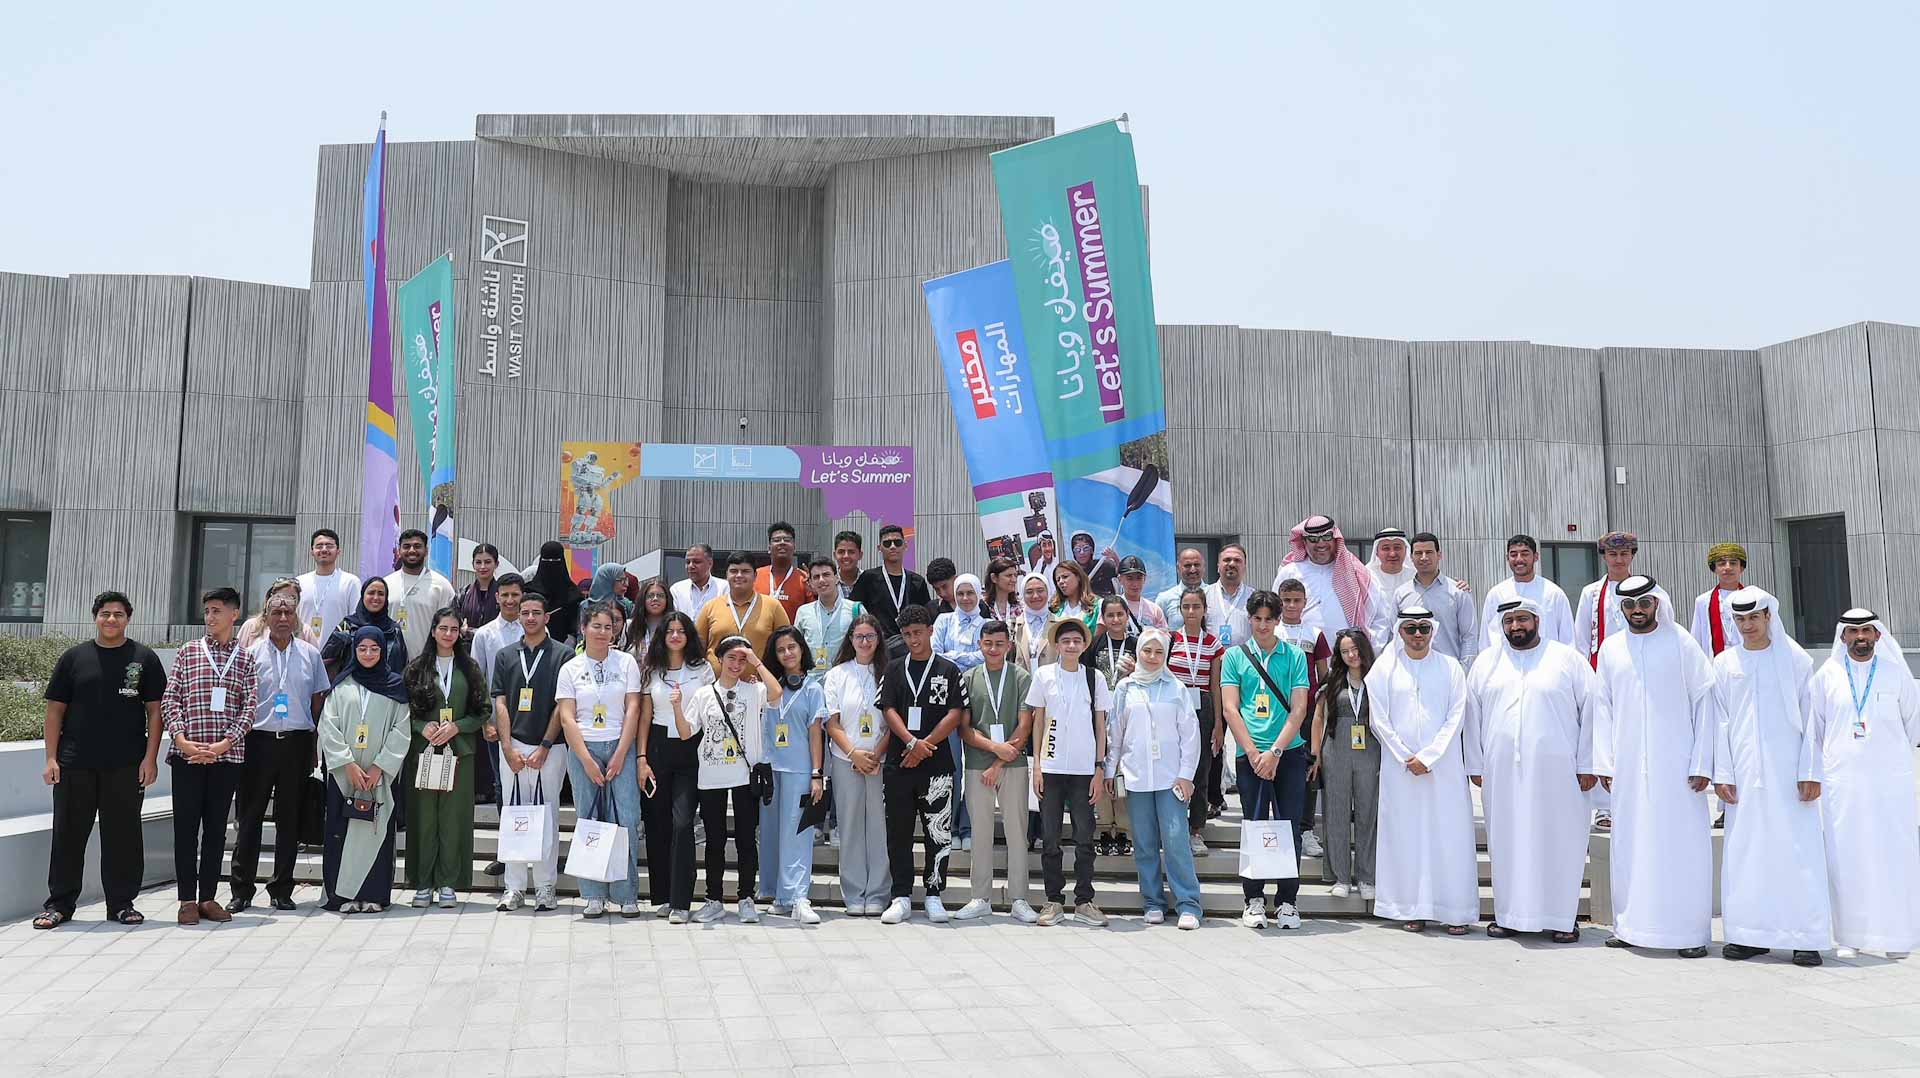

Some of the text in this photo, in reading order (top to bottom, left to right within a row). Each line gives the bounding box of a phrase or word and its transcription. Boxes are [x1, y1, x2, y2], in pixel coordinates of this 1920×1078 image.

[478, 270, 502, 377] ناشئة واسط
[508, 273, 525, 378] WASIT YOUTH
[1041, 223, 1086, 399] صيفك ويانا
[1073, 190, 1124, 411] Let's Summer
[960, 340, 998, 406] مختبر
[984, 321, 1022, 414] المهارات
[811, 469, 911, 484] Let's Summer
[822, 451, 900, 468] صيفك ويانا
